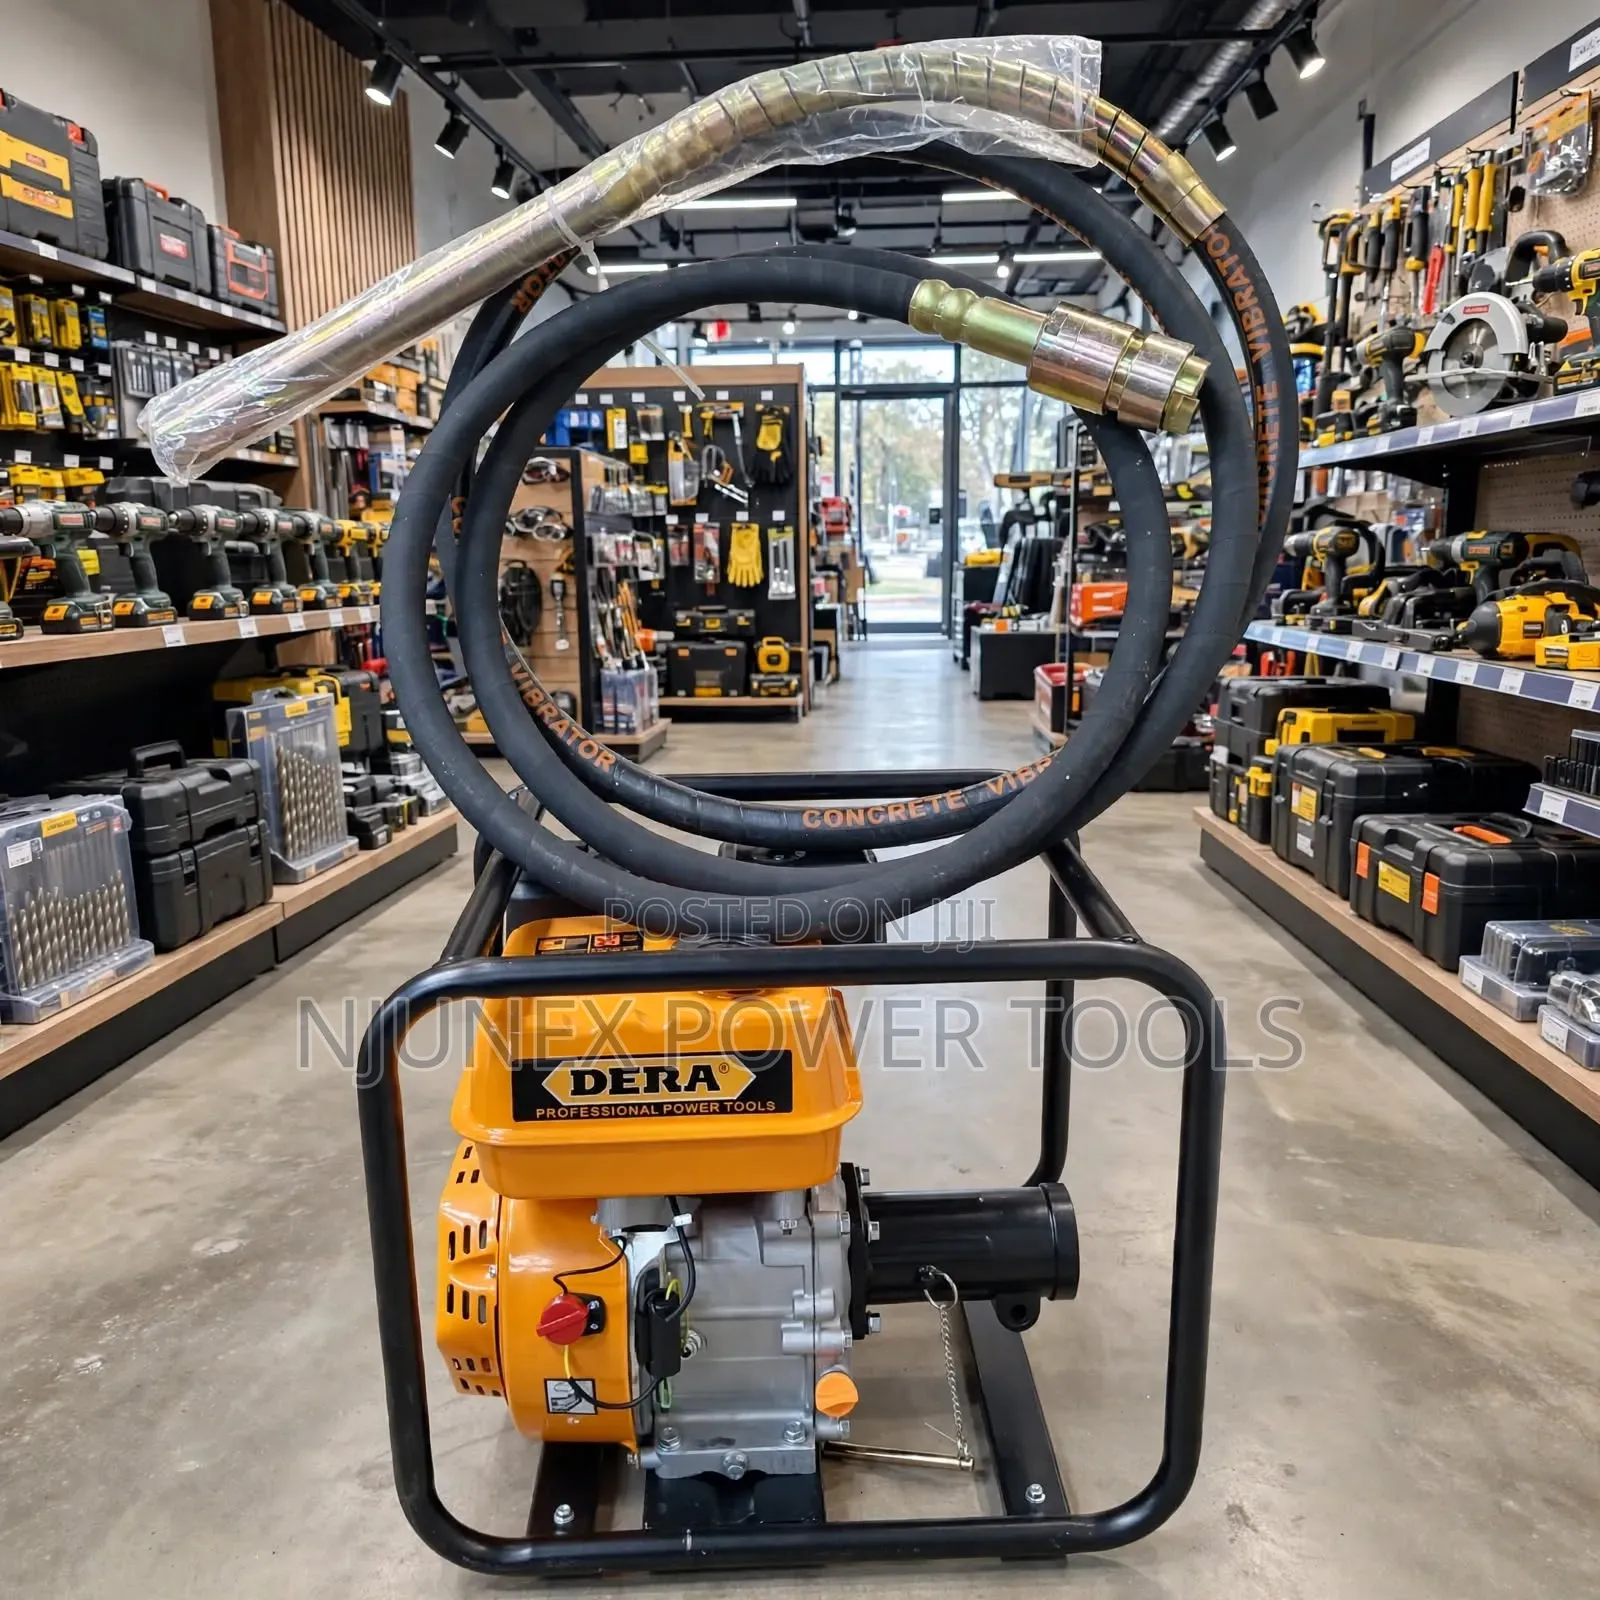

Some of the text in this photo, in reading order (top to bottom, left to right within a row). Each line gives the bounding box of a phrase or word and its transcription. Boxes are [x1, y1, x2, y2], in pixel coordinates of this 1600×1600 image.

[511, 661, 617, 774] VIBRATOR
[802, 789, 966, 829] CONCRETE
[536, 1100, 776, 1119] PROFESSIONAL POWER TOOLS
